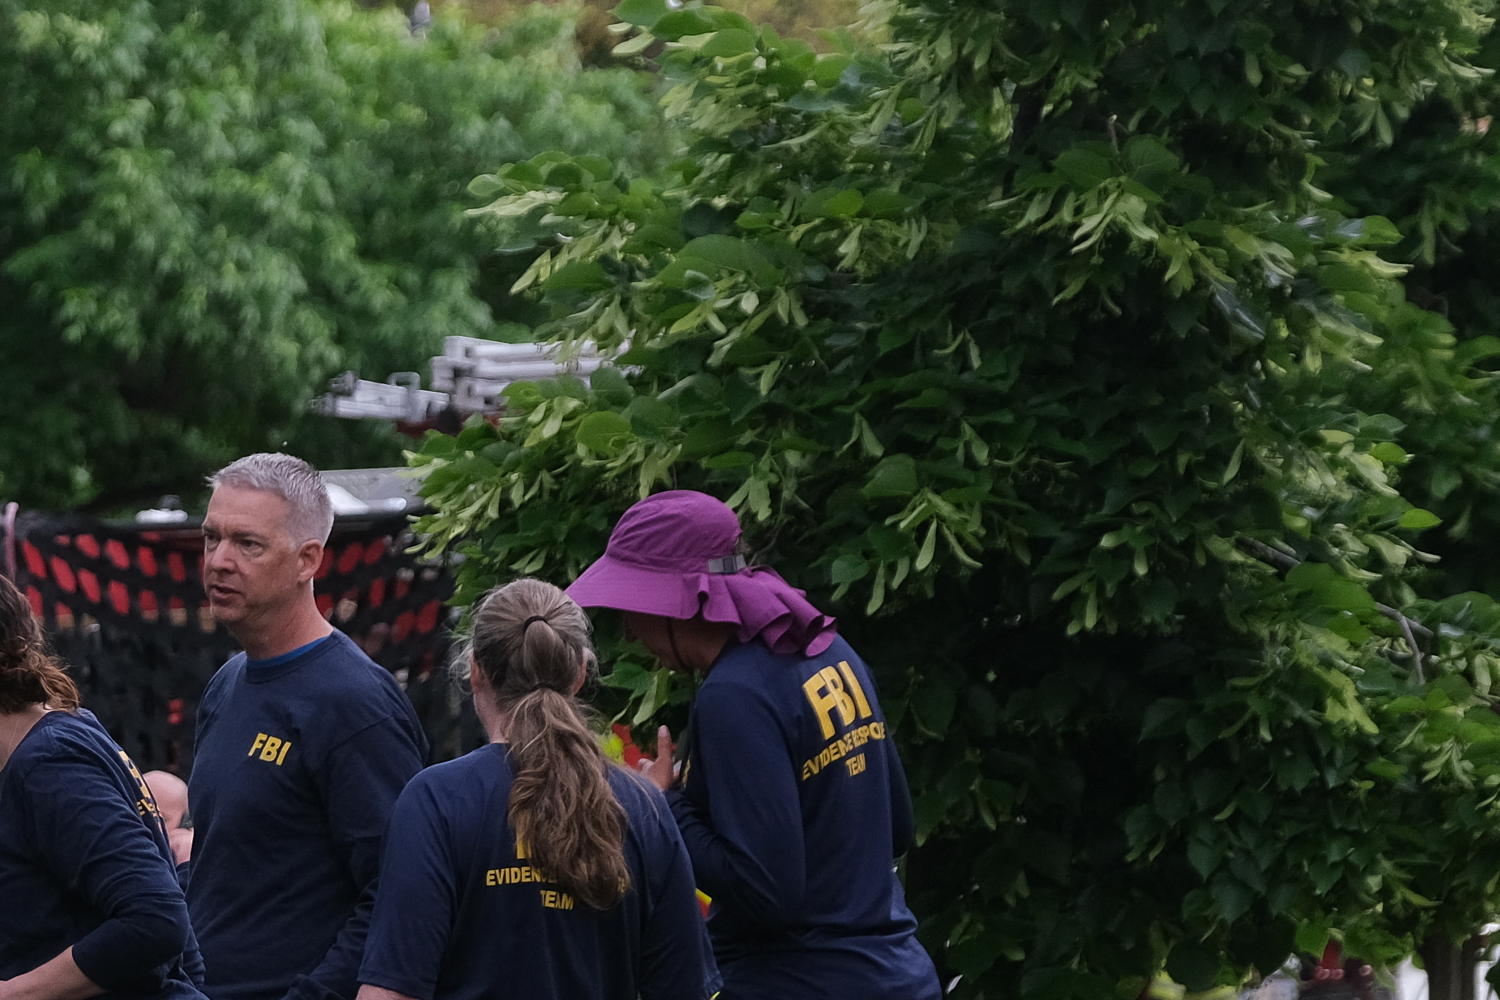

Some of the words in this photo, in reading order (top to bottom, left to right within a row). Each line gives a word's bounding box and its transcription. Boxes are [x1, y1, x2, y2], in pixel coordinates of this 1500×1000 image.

[802, 660, 873, 740] FBI
[247, 732, 292, 766] FBI
[540, 889, 574, 911] TEAM
